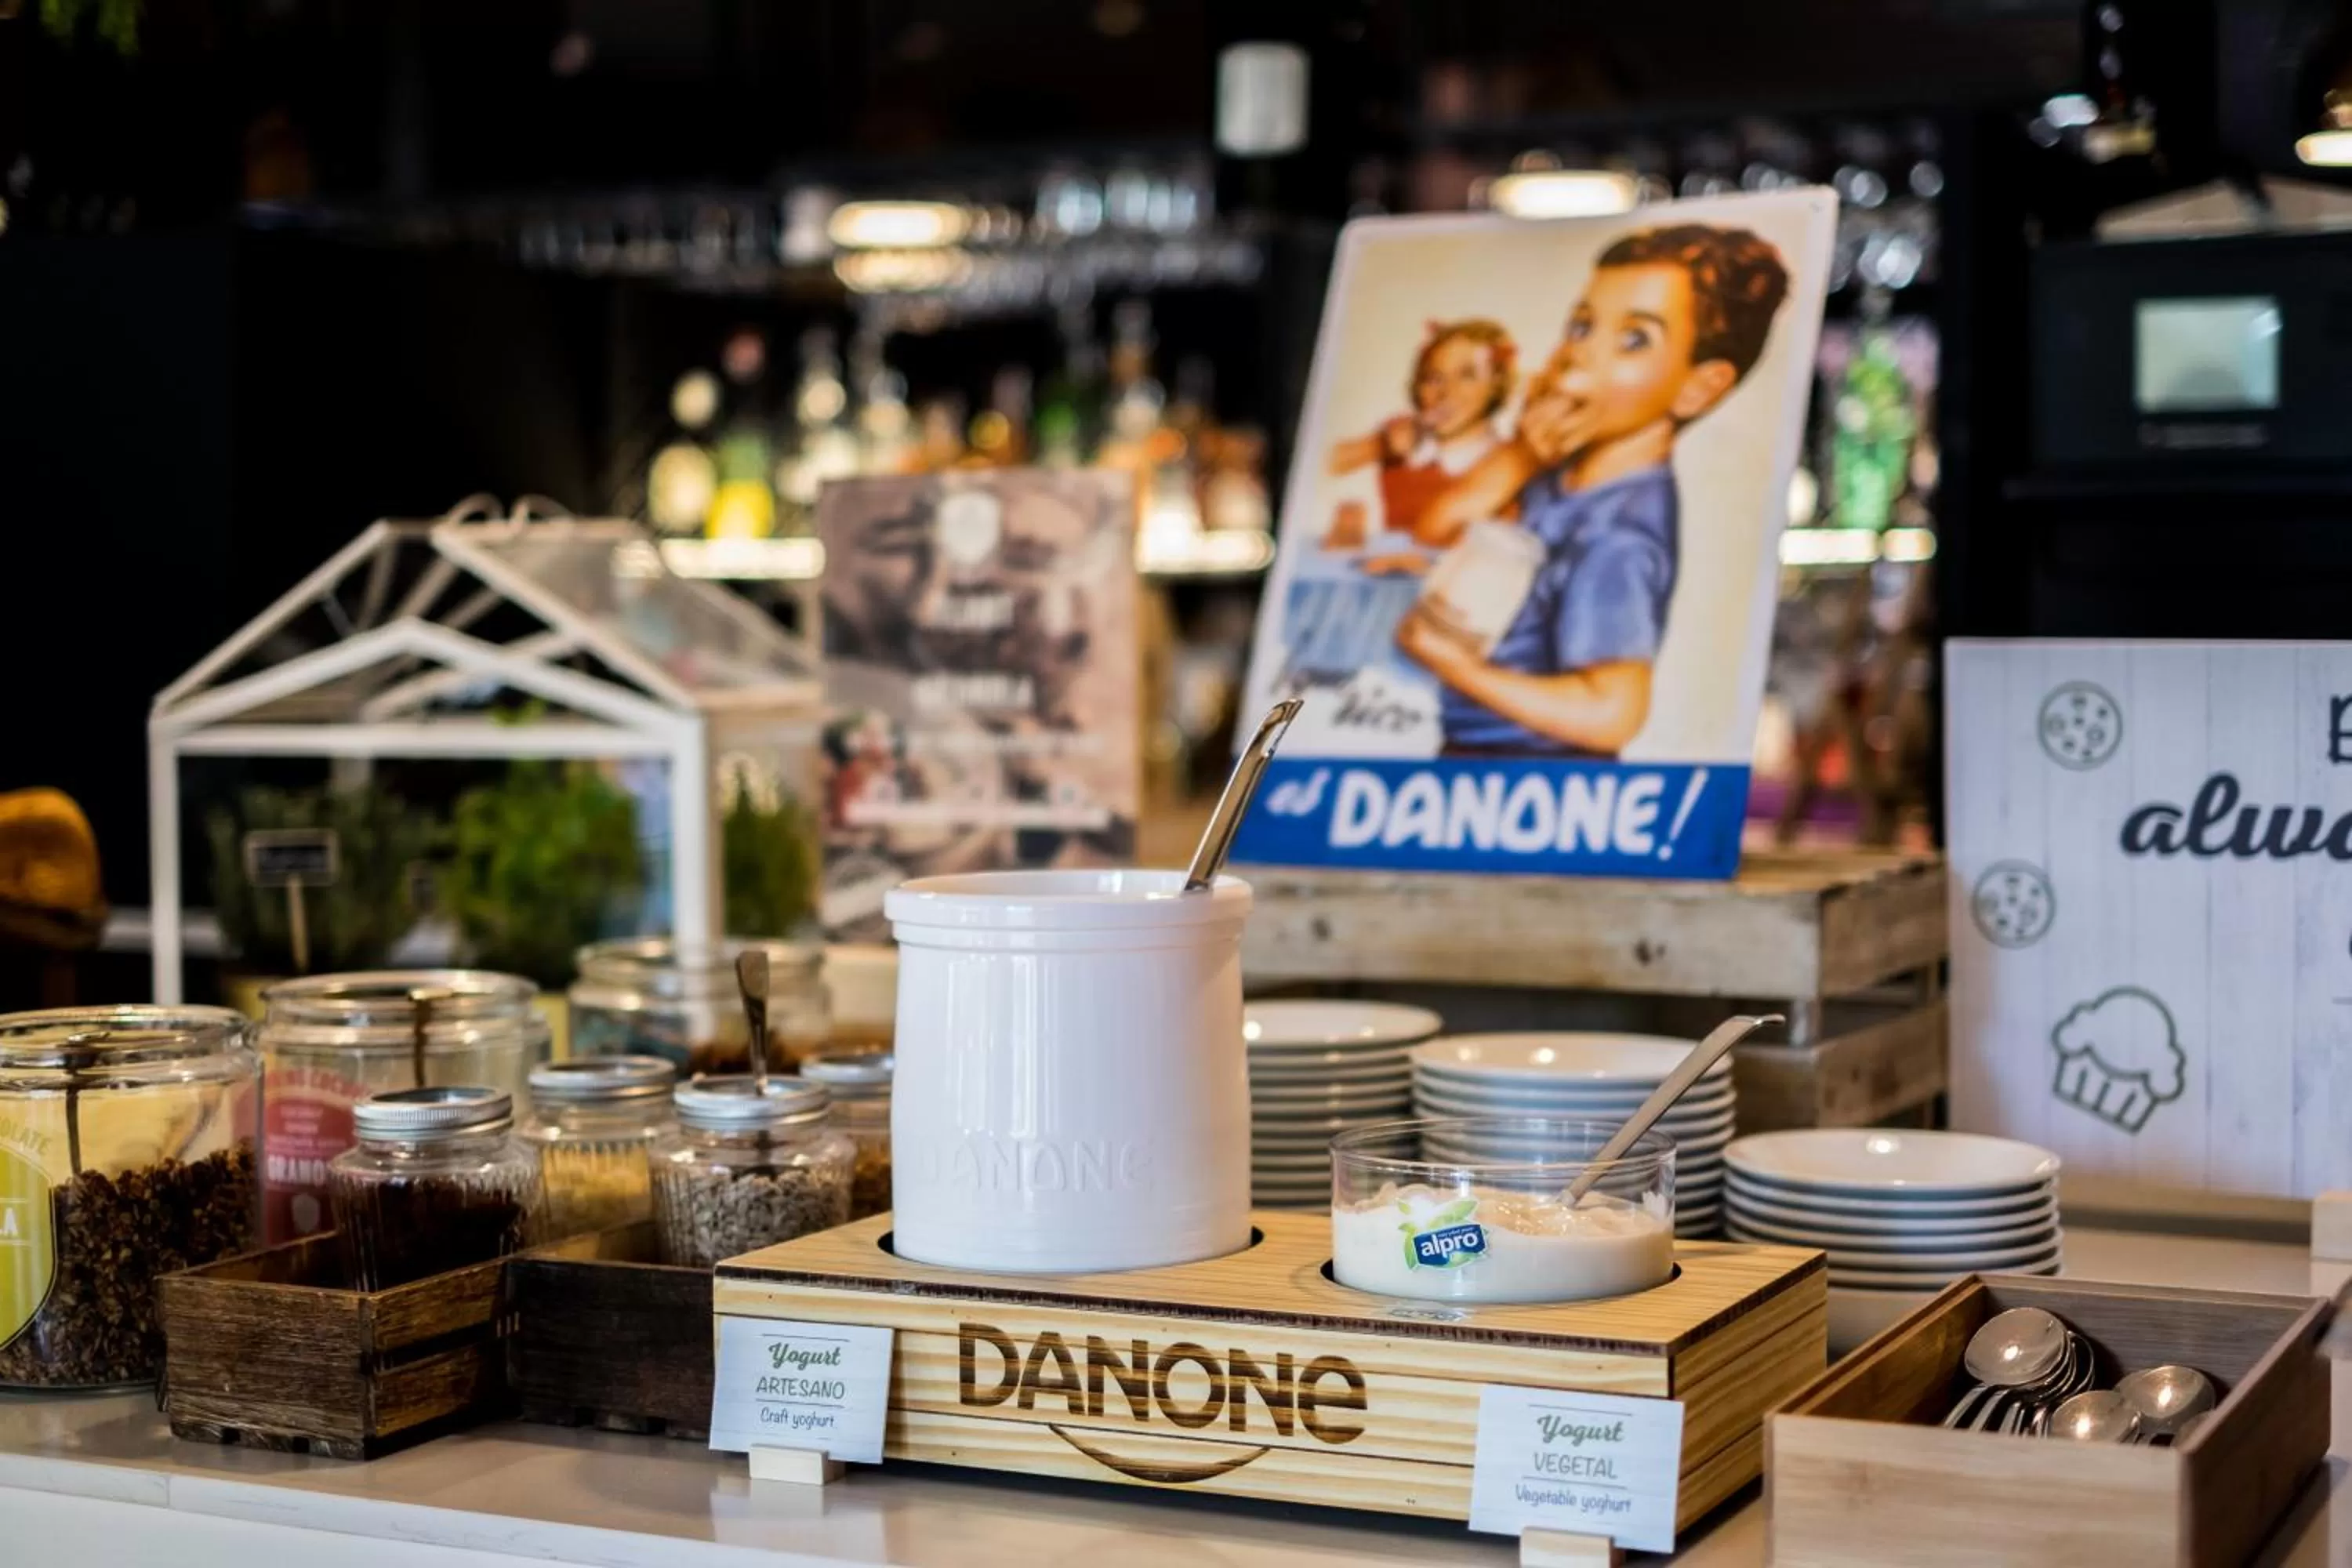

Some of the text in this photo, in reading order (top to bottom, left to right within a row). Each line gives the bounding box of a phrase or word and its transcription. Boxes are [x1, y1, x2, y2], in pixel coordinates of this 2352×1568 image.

[1328, 768, 1709, 862] DANONE!
[1421, 1233, 1478, 1258] alpro
[768, 1342, 841, 1370] Yogurt
[755, 1376, 845, 1400] ARTESANO
[760, 1406, 835, 1431] Craft yoghurt
[1537, 1414, 1625, 1447] Yogurt
[1534, 1451, 1618, 1479] VEGETAL
[1515, 1484, 1632, 1515] Vegetable yoghurt
